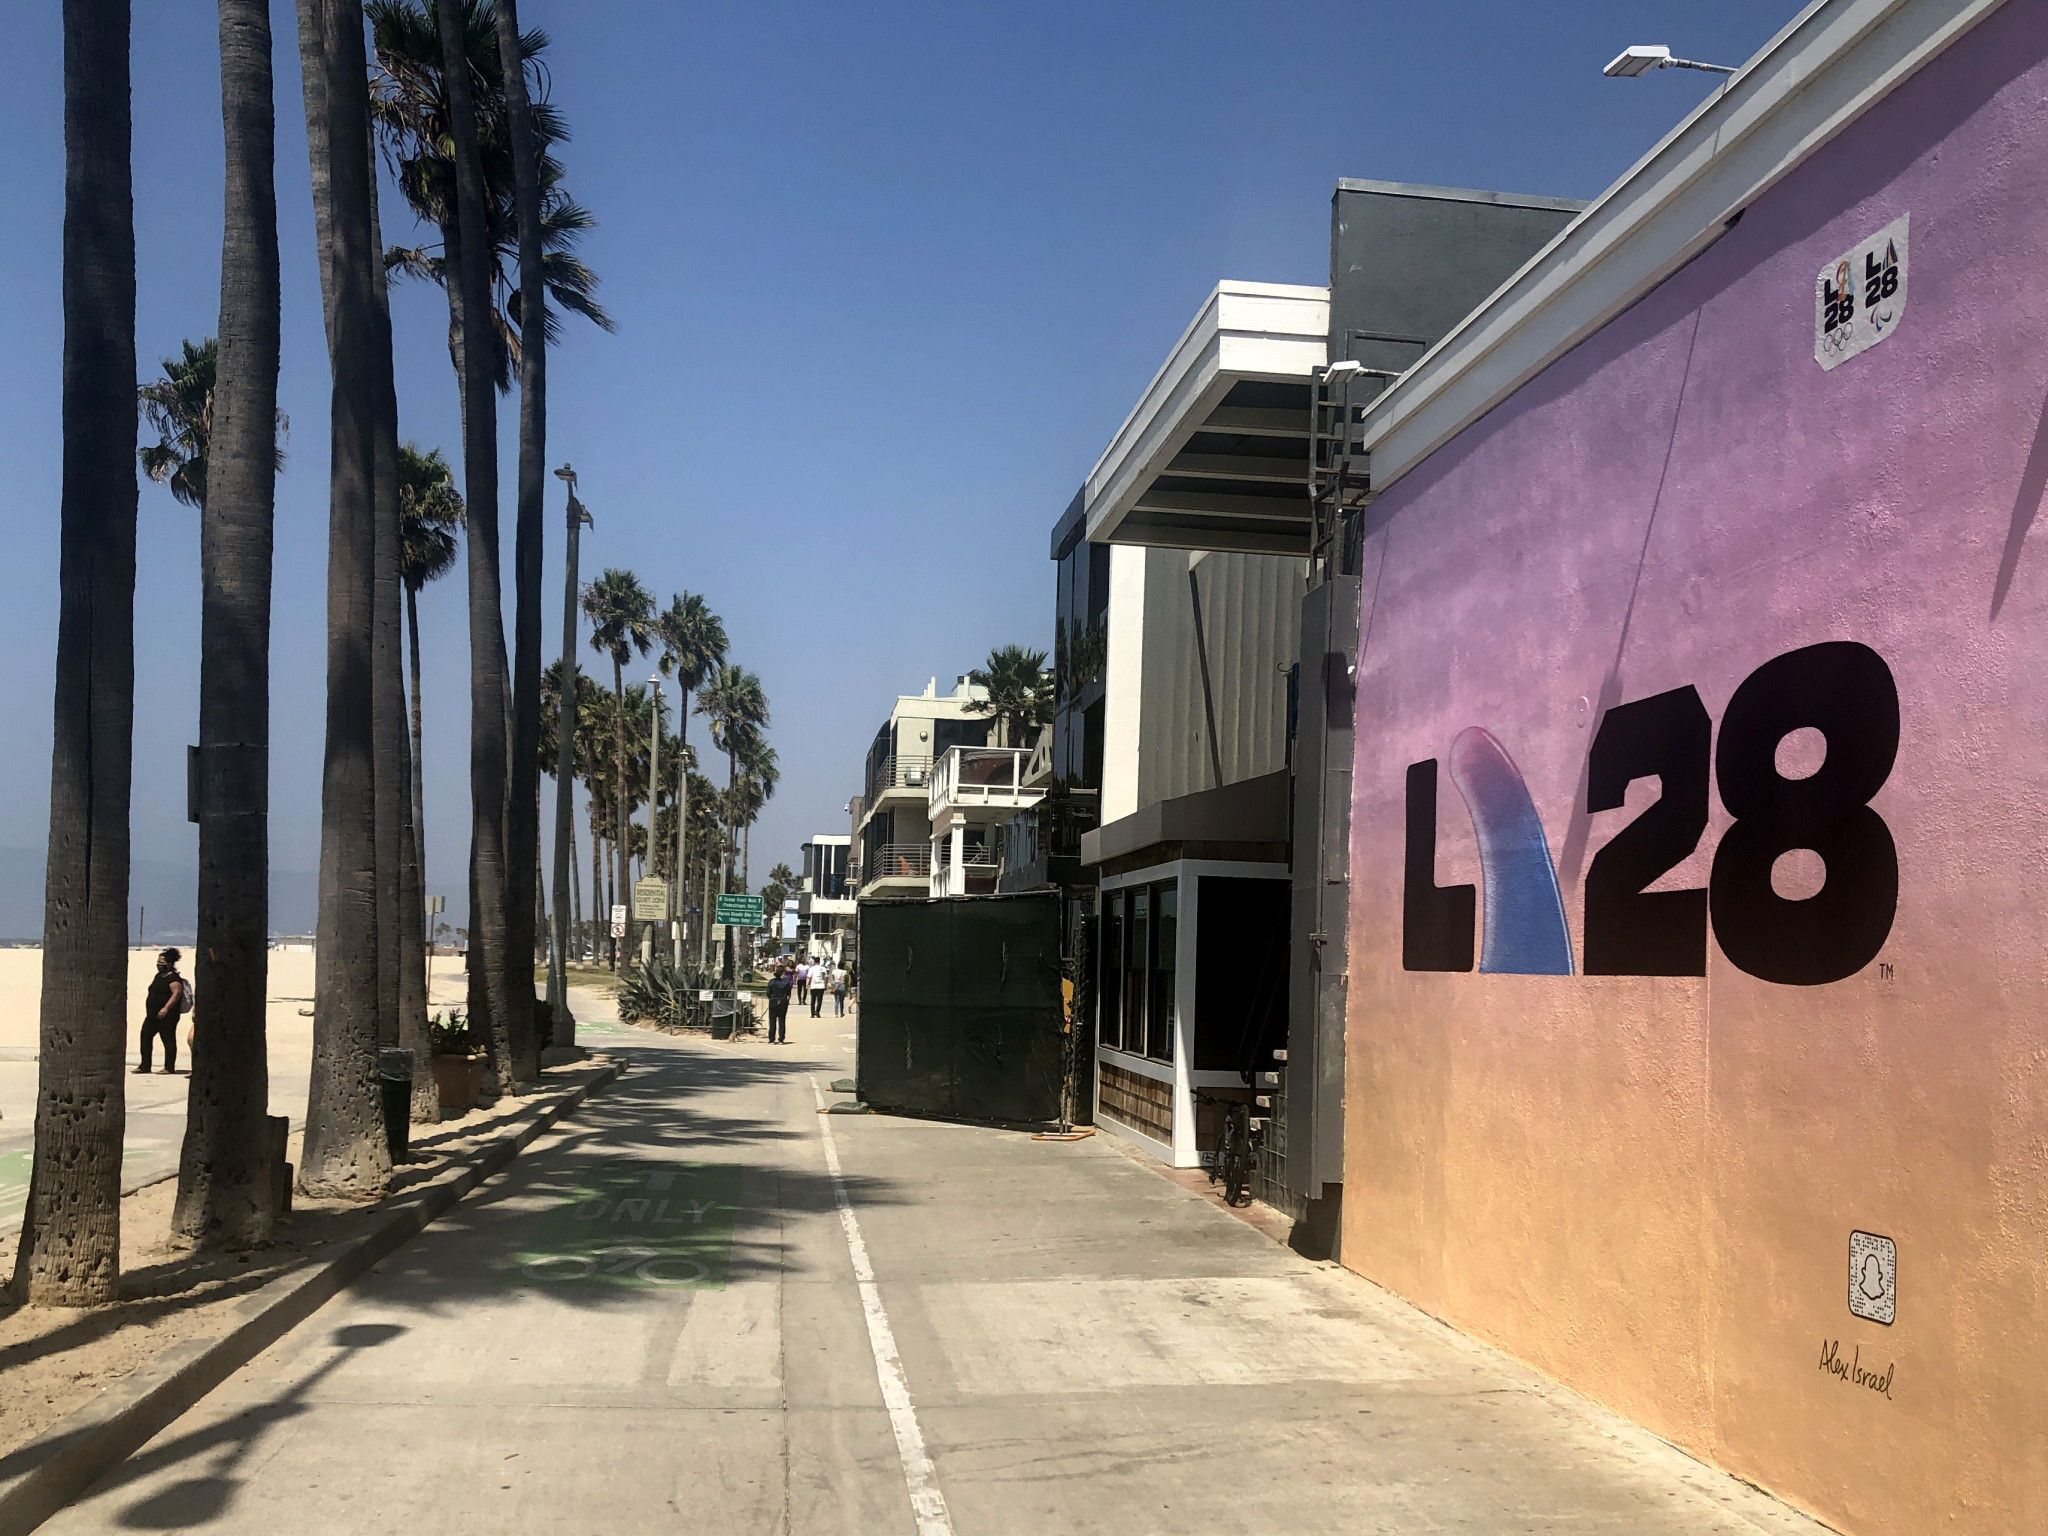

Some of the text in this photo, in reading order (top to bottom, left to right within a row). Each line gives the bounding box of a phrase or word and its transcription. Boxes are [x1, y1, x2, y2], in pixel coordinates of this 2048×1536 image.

[1865, 266, 1899, 309] 28
[1824, 294, 1855, 334] 28
[1879, 963, 1894, 981] TM
[572, 1198, 716, 1223] ONLY
[1818, 1338, 1895, 1401] Alex Israel
